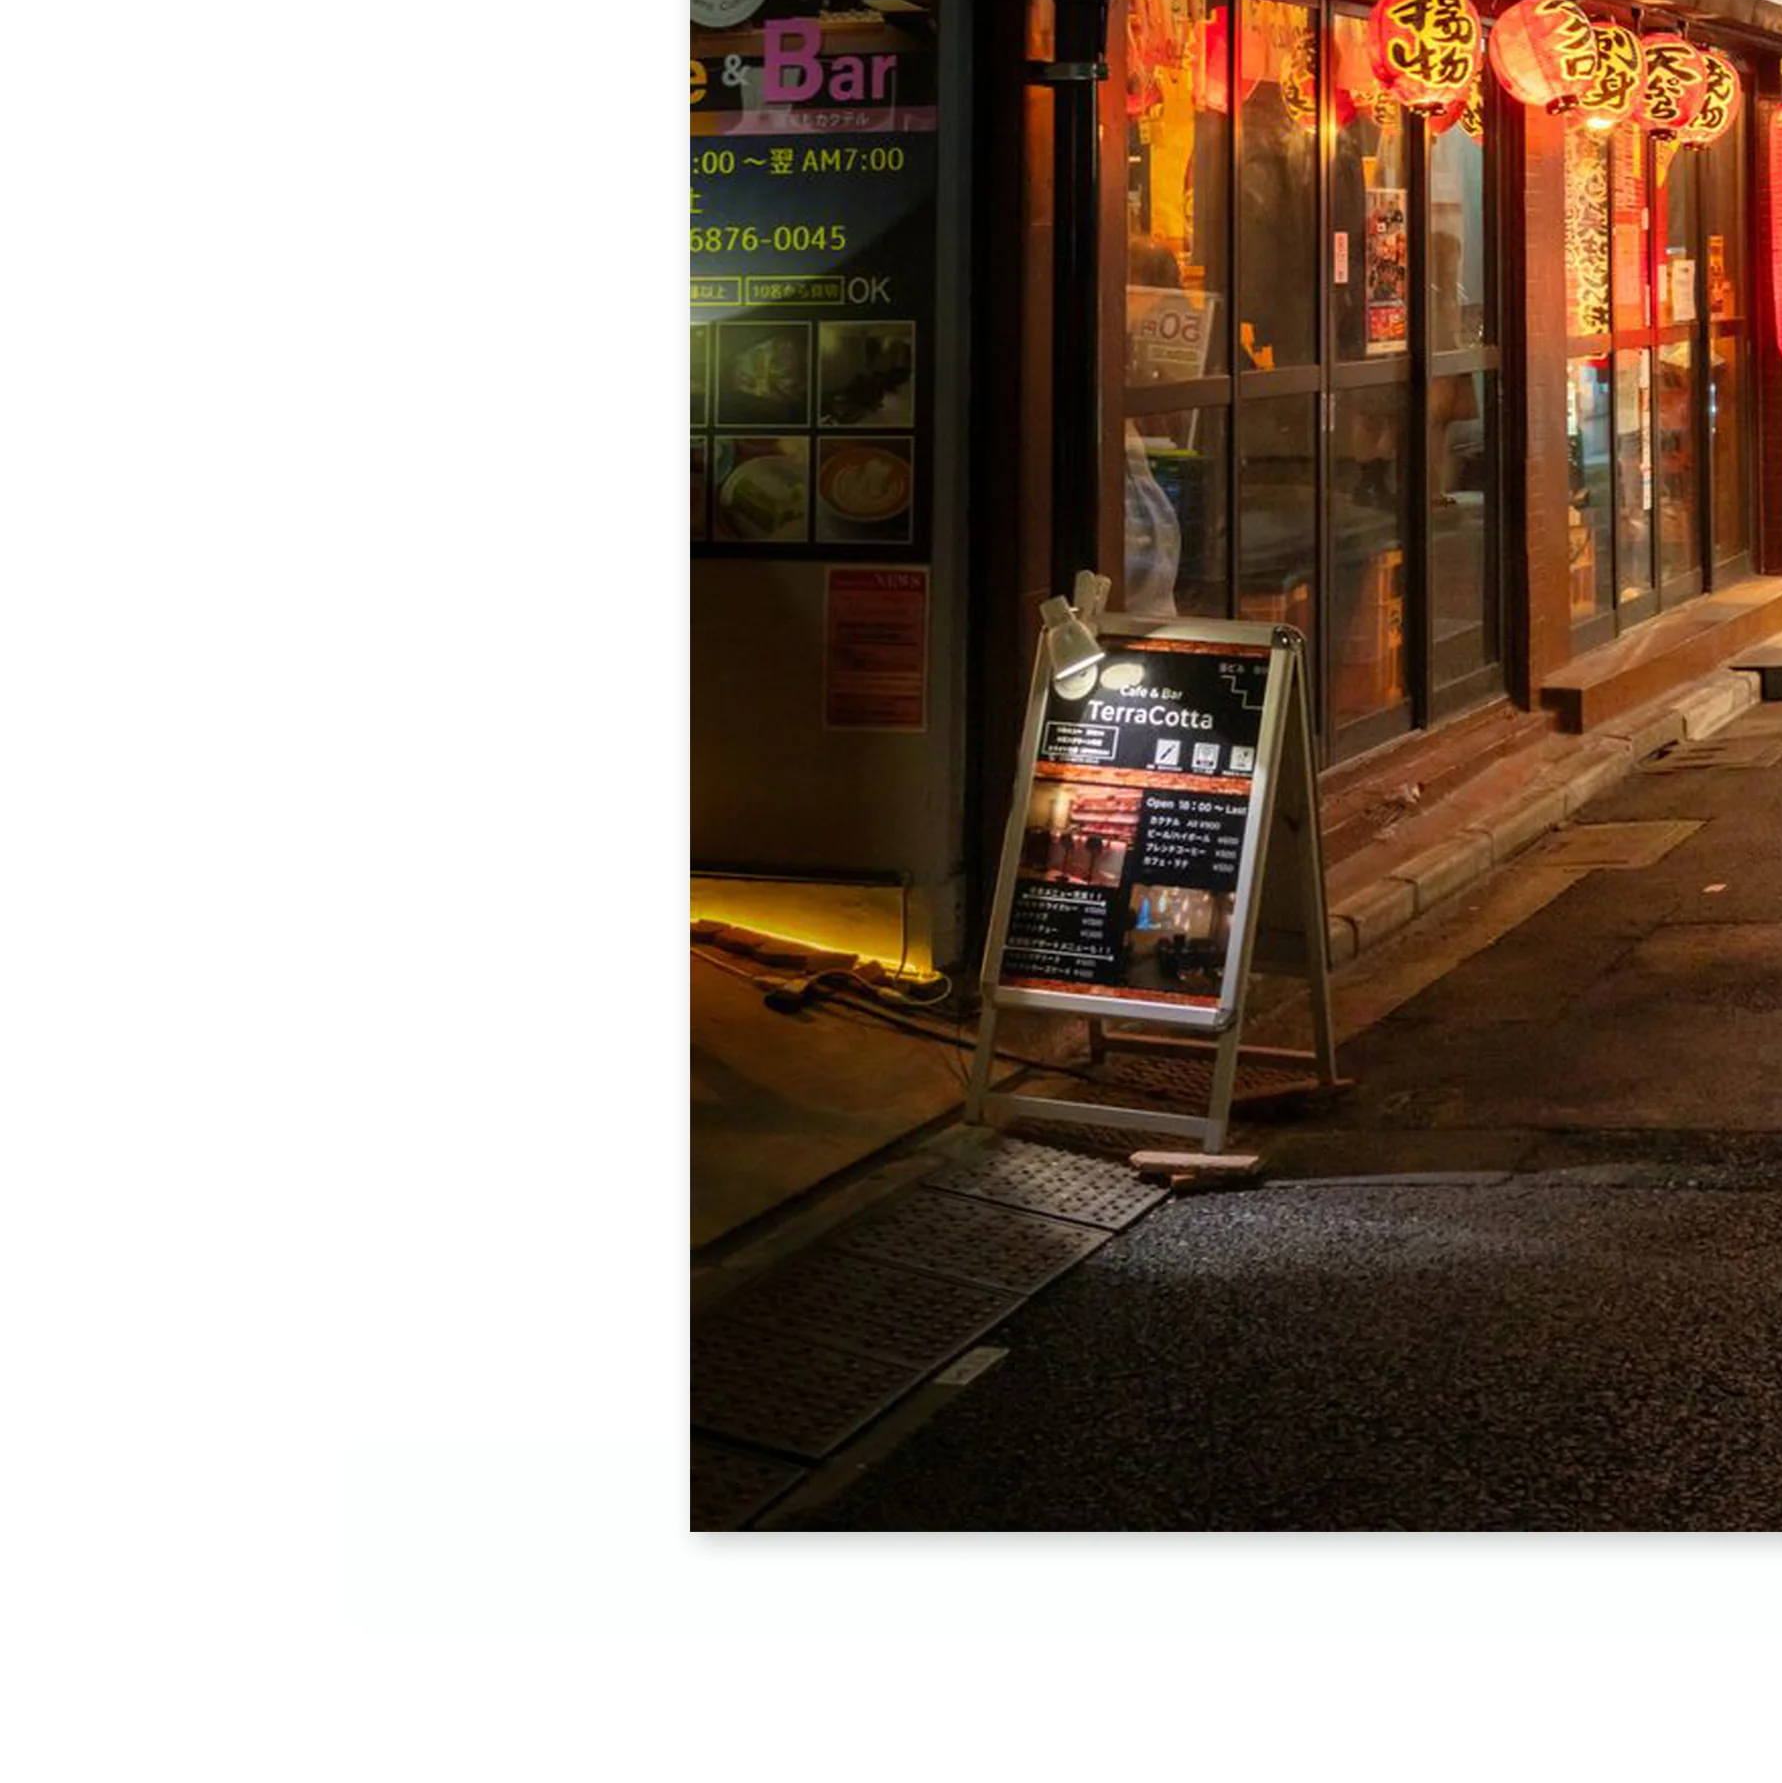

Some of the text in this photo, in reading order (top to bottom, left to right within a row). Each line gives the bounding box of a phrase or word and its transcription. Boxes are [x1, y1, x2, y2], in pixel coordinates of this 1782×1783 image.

[722, 54, 751, 86] &
[764, 18, 897, 103] Bar
[1645, 46, 1698, 117] 天ぷら
[802, 147, 904, 172] AM7:00
[848, 276, 892, 304] OK
[1120, 684, 1183, 700] Cafe & Bar
[1088, 700, 1214, 730] TerraCotta
[1146, 797, 1174, 809] Open
